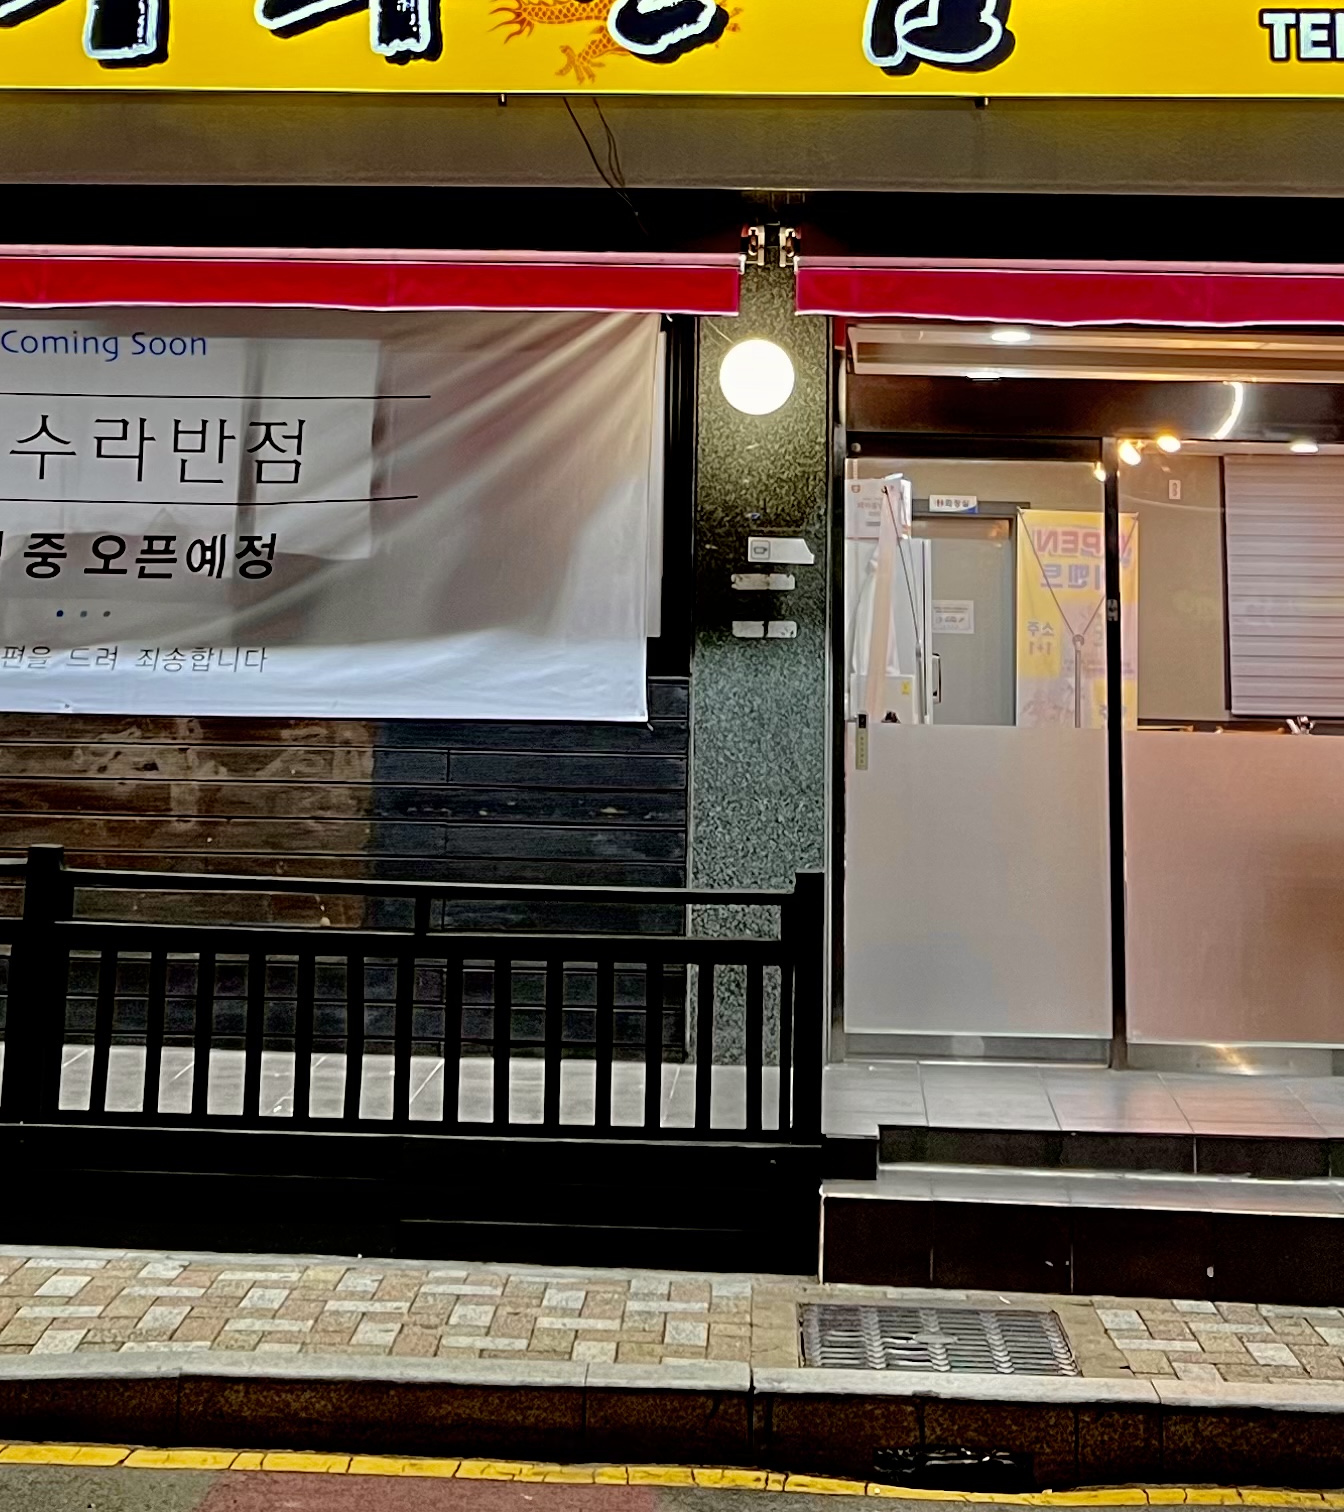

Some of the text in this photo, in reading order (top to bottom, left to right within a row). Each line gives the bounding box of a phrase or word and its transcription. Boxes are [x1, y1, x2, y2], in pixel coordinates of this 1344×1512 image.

[0, 329, 208, 363] Coming Soon
[9, 414, 307, 485] 수라반점
[23, 532, 68, 578] 중
[83, 532, 277, 580] 오픈예정
[65, 645, 120, 672] 드려
[135, 646, 269, 674] 죄송합니다
